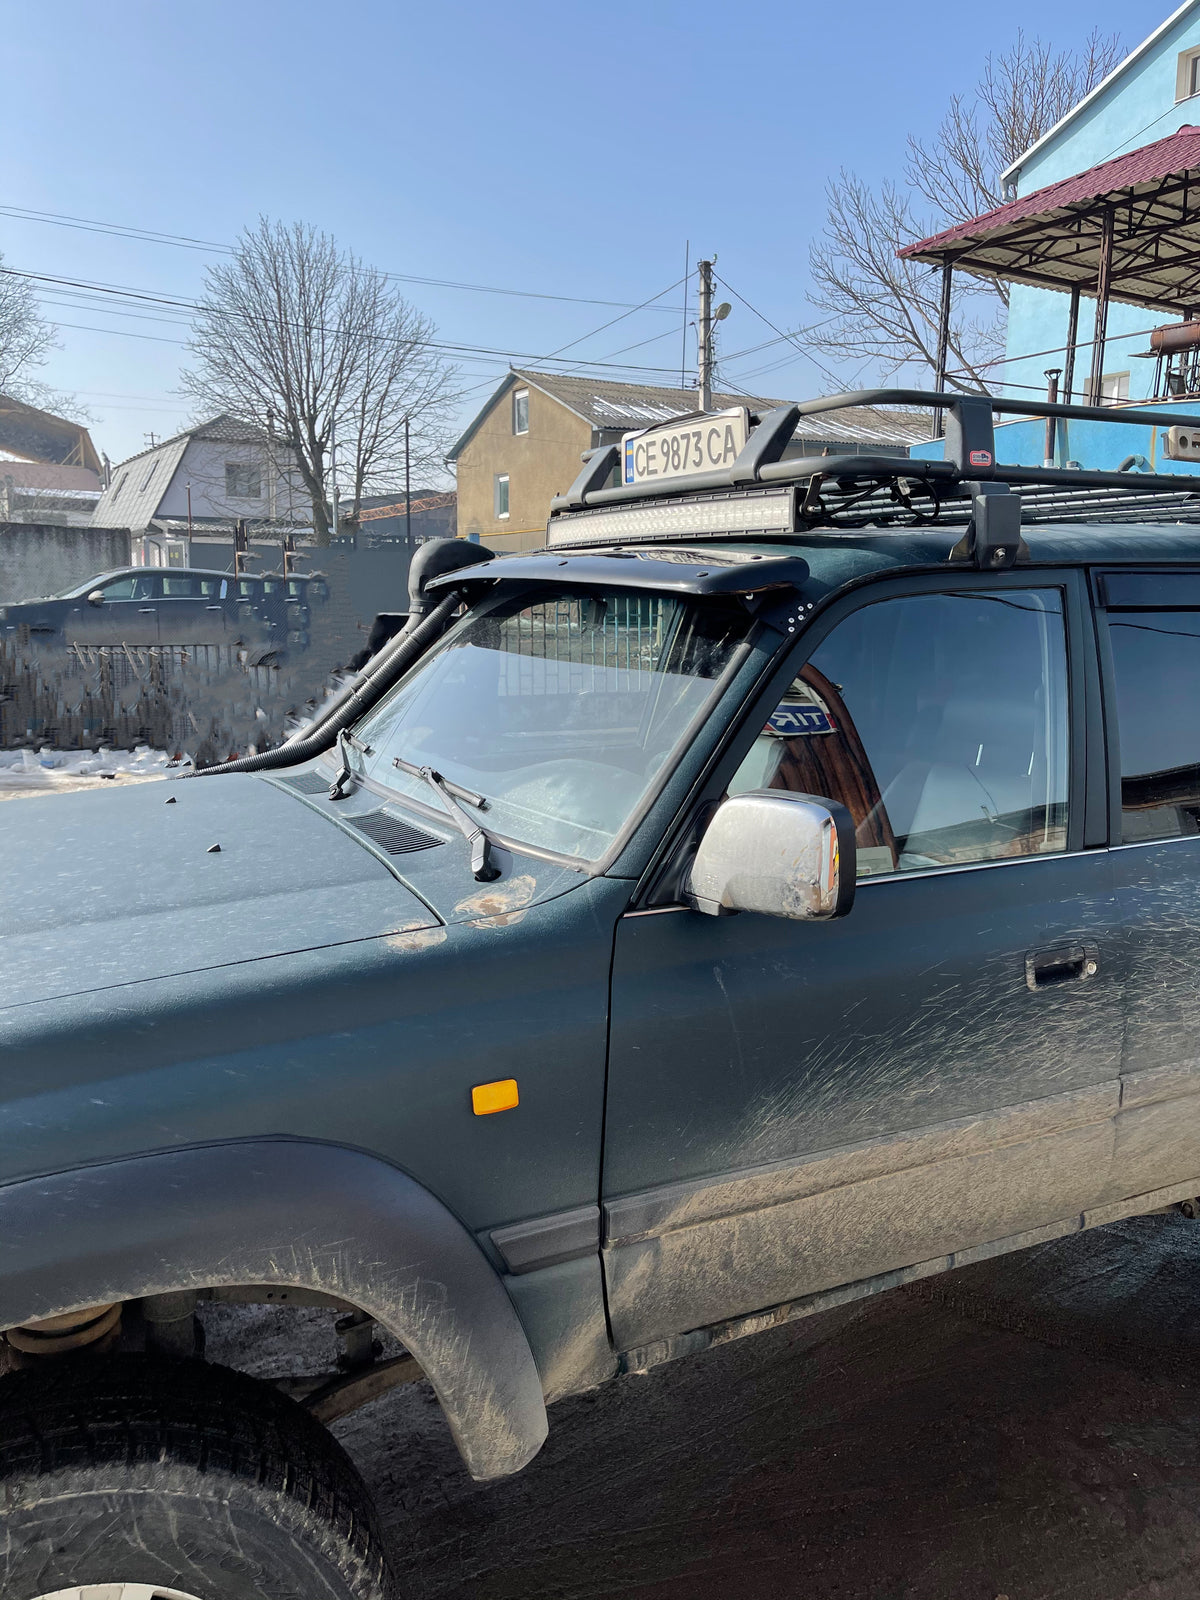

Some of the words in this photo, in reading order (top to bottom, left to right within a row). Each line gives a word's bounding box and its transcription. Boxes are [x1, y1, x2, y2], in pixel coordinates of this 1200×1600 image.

[635, 440, 658, 477] CE
[661, 430, 703, 473] 9873
[707, 424, 738, 465] CA
